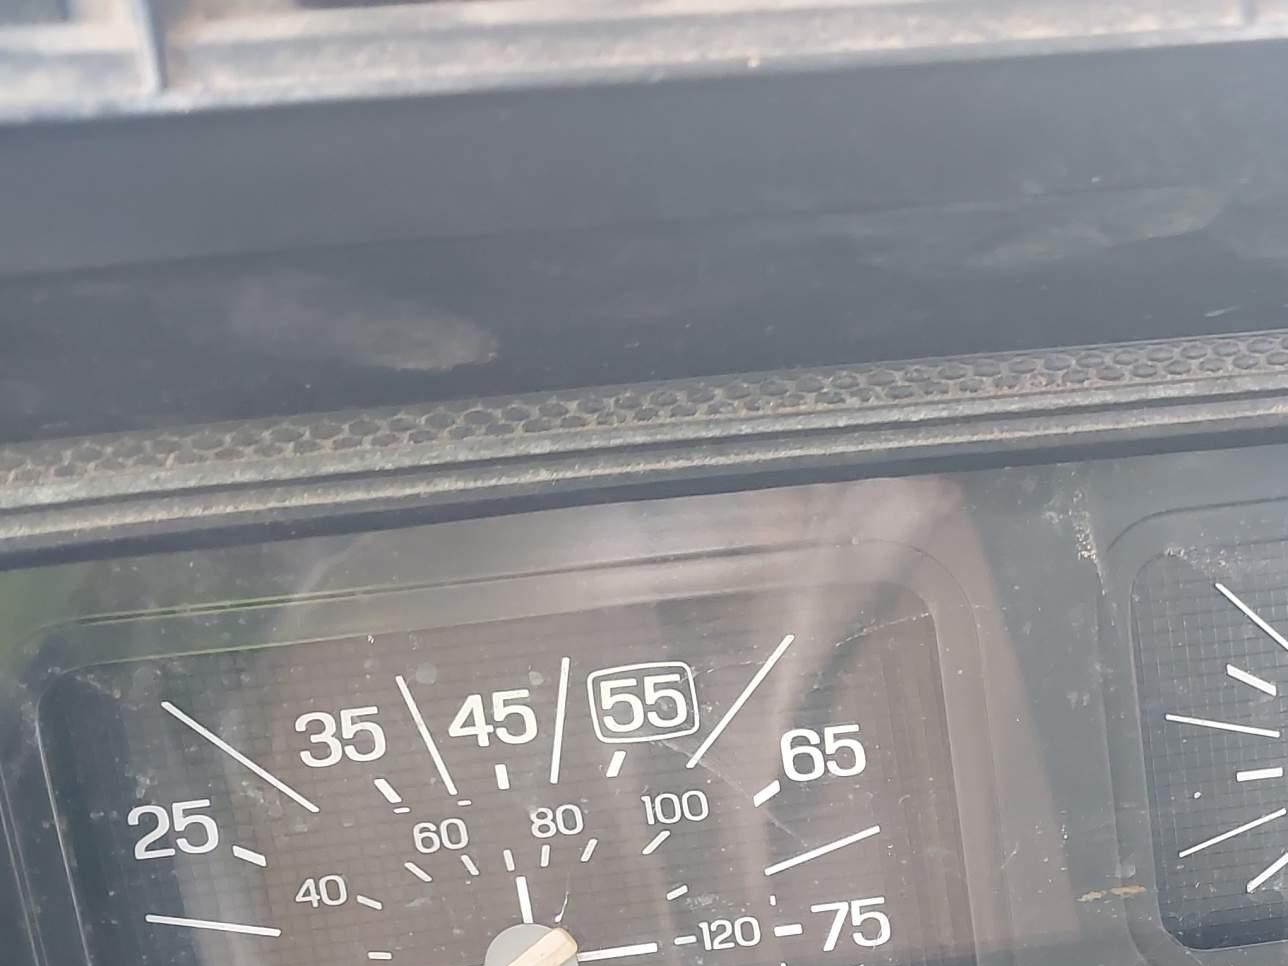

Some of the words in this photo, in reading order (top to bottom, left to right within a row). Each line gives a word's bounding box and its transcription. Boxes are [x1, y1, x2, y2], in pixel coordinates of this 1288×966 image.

[448, 689, 539, 747] 45
[600, 673, 689, 733] 55
[294, 706, 387, 767] 35
[780, 724, 867, 782] 65
[127, 799, 220, 860] 25
[529, 804, 584, 838] 80
[641, 790, 710, 825] 100
[412, 818, 469, 854] 60
[295, 875, 347, 907] 40
[698, 916, 761, 950] 120
[810, 896, 892, 951] 75
